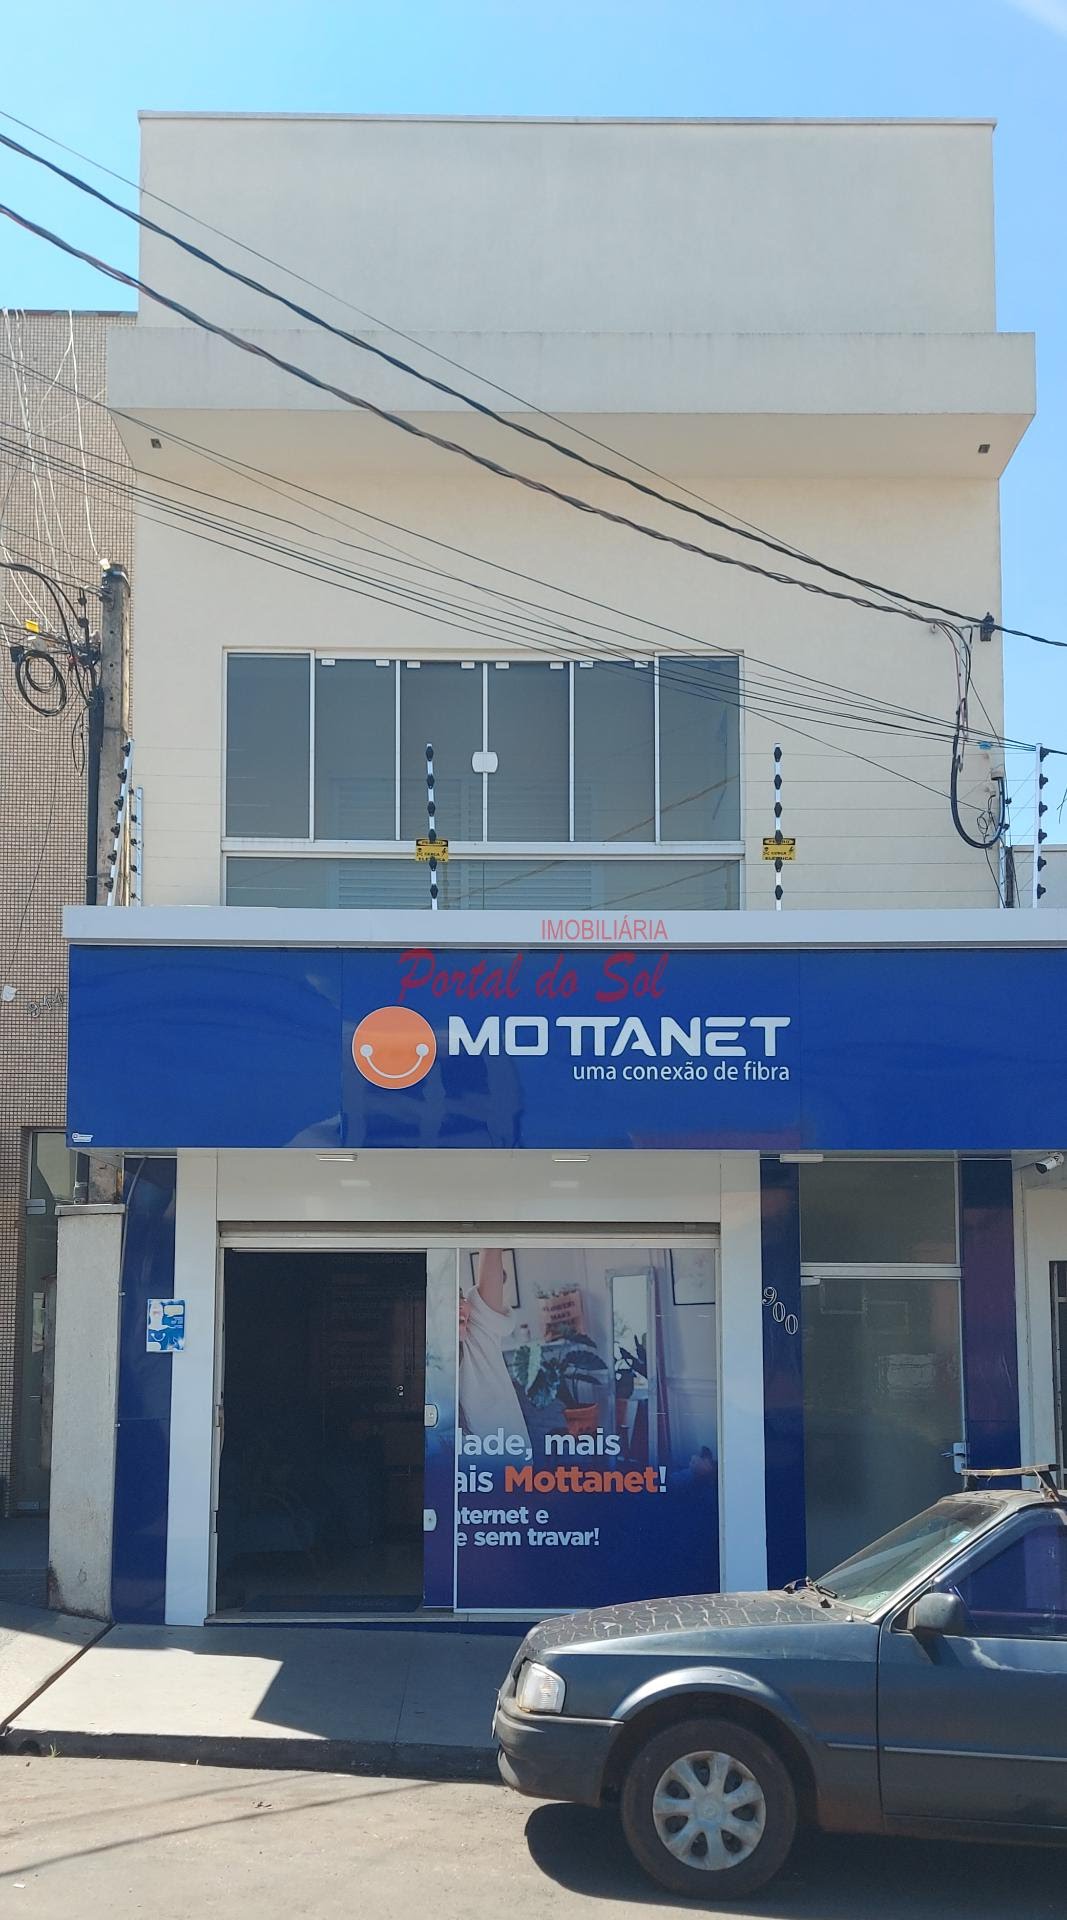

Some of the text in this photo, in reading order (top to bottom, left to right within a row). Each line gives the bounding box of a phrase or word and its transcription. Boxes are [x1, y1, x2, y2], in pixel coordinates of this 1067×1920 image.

[448, 1015, 791, 1057] MOTTANET
[573, 1060, 790, 1081] uma conexão de fibra
[761, 1286, 799, 1335] 900
[544, 1427, 622, 1456] mais
[504, 1465, 667, 1493] Mottanet!
[535, 1509, 549, 1525] e
[473, 1530, 521, 1547] sem
[526, 1527, 600, 1546] travar!
